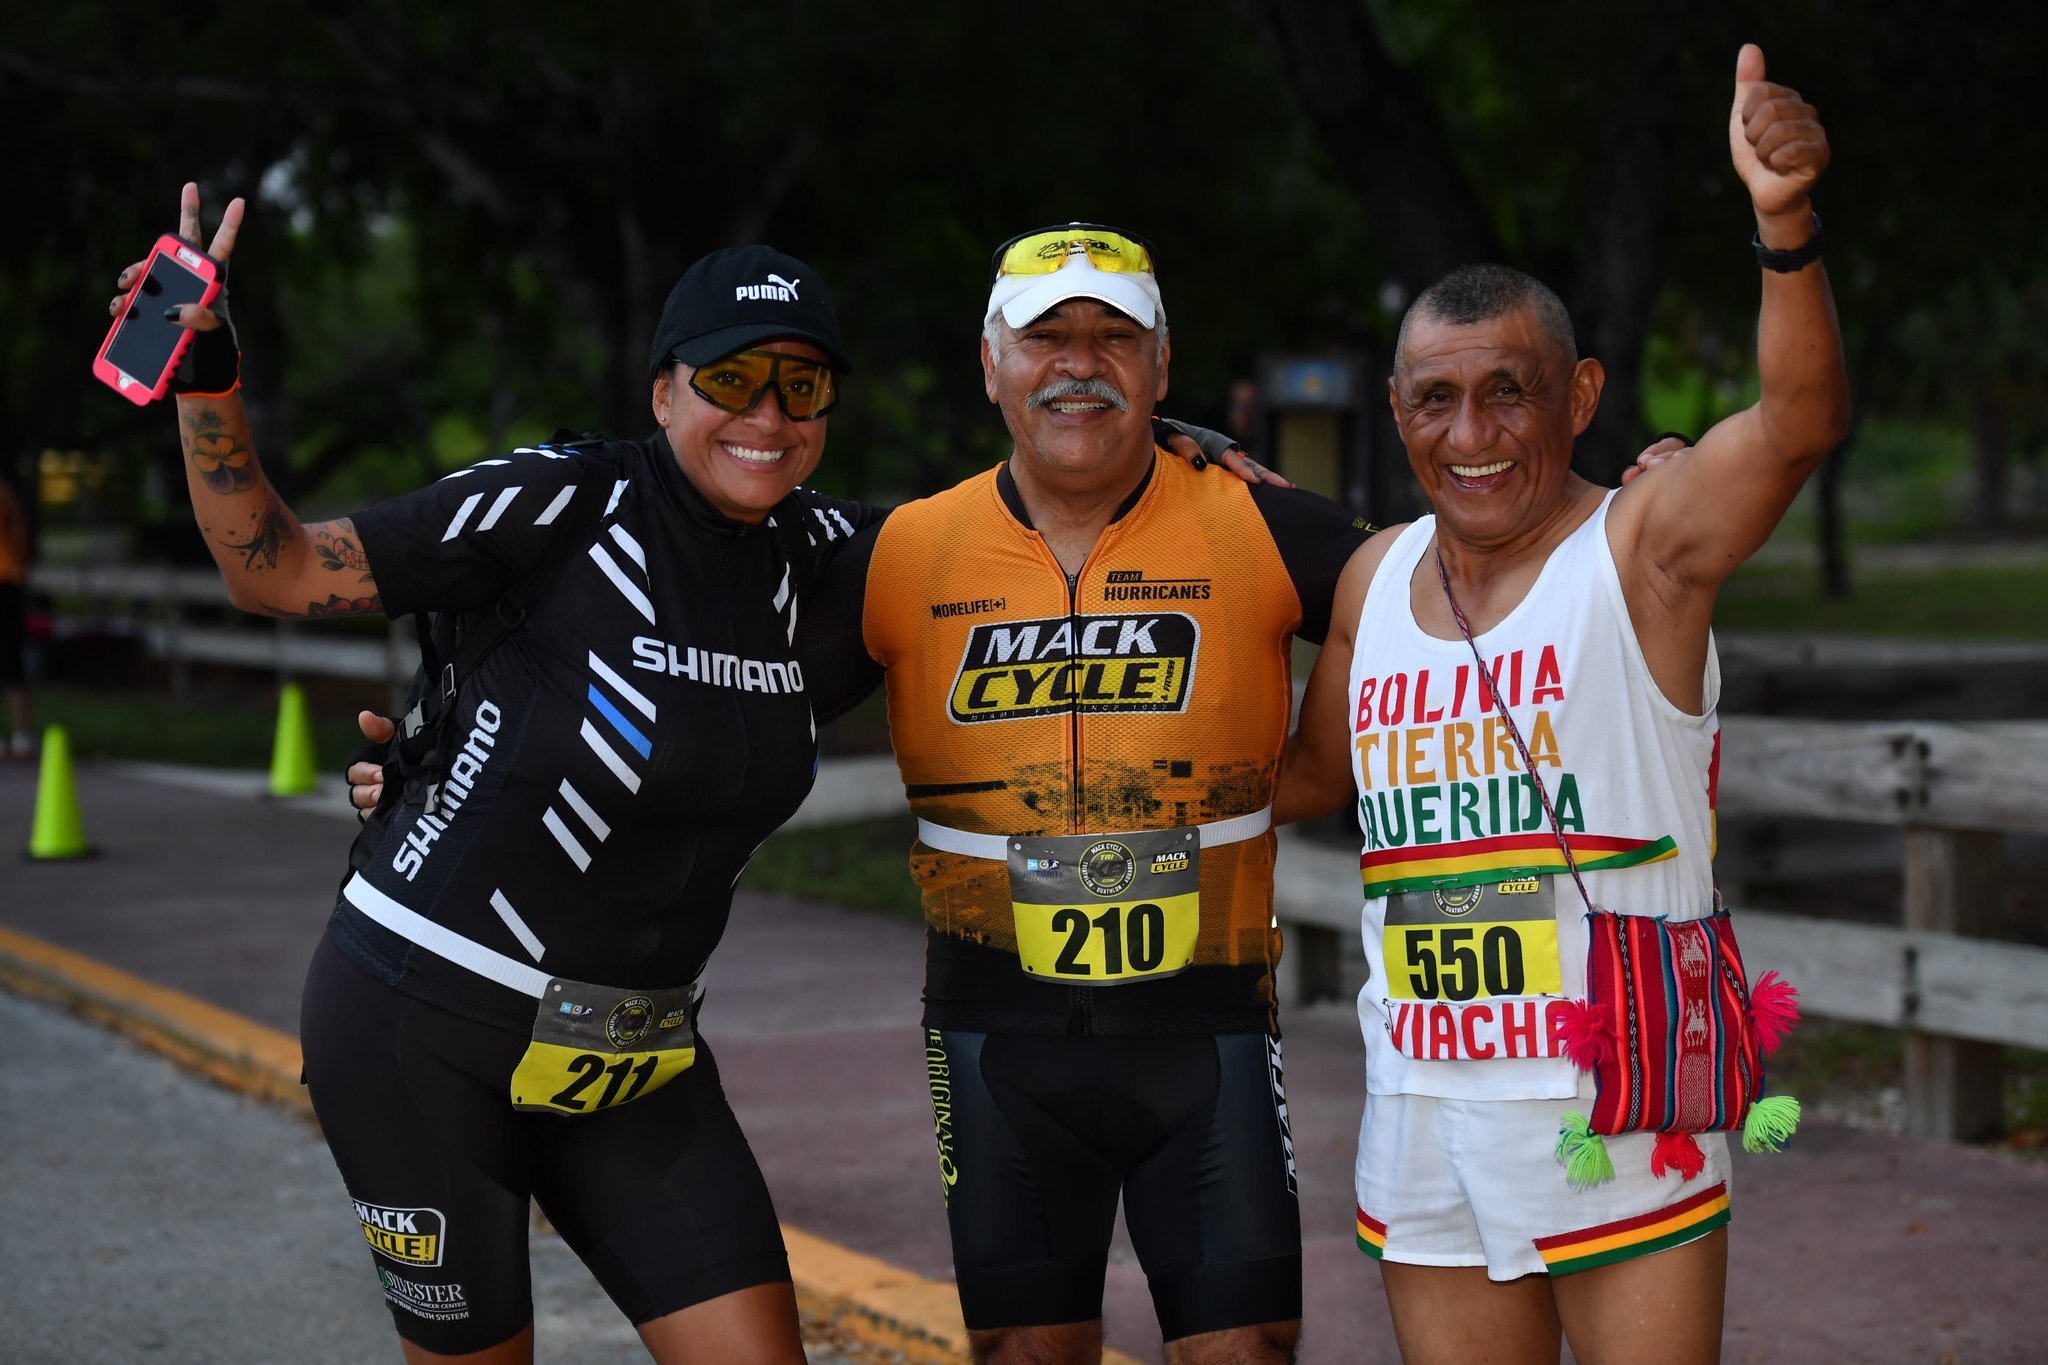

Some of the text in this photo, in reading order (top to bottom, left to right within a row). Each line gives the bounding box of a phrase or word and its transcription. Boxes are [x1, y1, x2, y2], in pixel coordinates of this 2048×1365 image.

[736, 285, 790, 302] PUMA
[1104, 585, 1211, 601] HURRICANES
[1111, 573, 1140, 582] TEAM
[983, 619, 1160, 665] MACK
[632, 636, 804, 694] SHIMANO
[967, 661, 1160, 709] CYCLE
[1356, 645, 1565, 733] BOLIVIA
[1356, 711, 1562, 791] TIERRA
[392, 700, 501, 882] SHIMANO
[1360, 773, 1585, 850] QUERIDA
[1091, 843, 1123, 854] MACK CYCLE
[1155, 852, 1187, 863] MACK
[1082, 861, 1094, 888] TRIATHLON
[1096, 885, 1122, 894] DUATHLON
[1154, 861, 1185, 872] CYCLE
[1501, 883, 1535, 892] CYCLE
[1052, 904, 1164, 975] 210
[1405, 926, 1525, 1001] 550
[550, 1054, 659, 1110] 211
[355, 1203, 418, 1234] MACK
[386, 1270, 465, 1302] SYLVESTER
[417, 1301, 467, 1309] CANCER CENTER
[435, 1311, 469, 1321] SYSTEM
